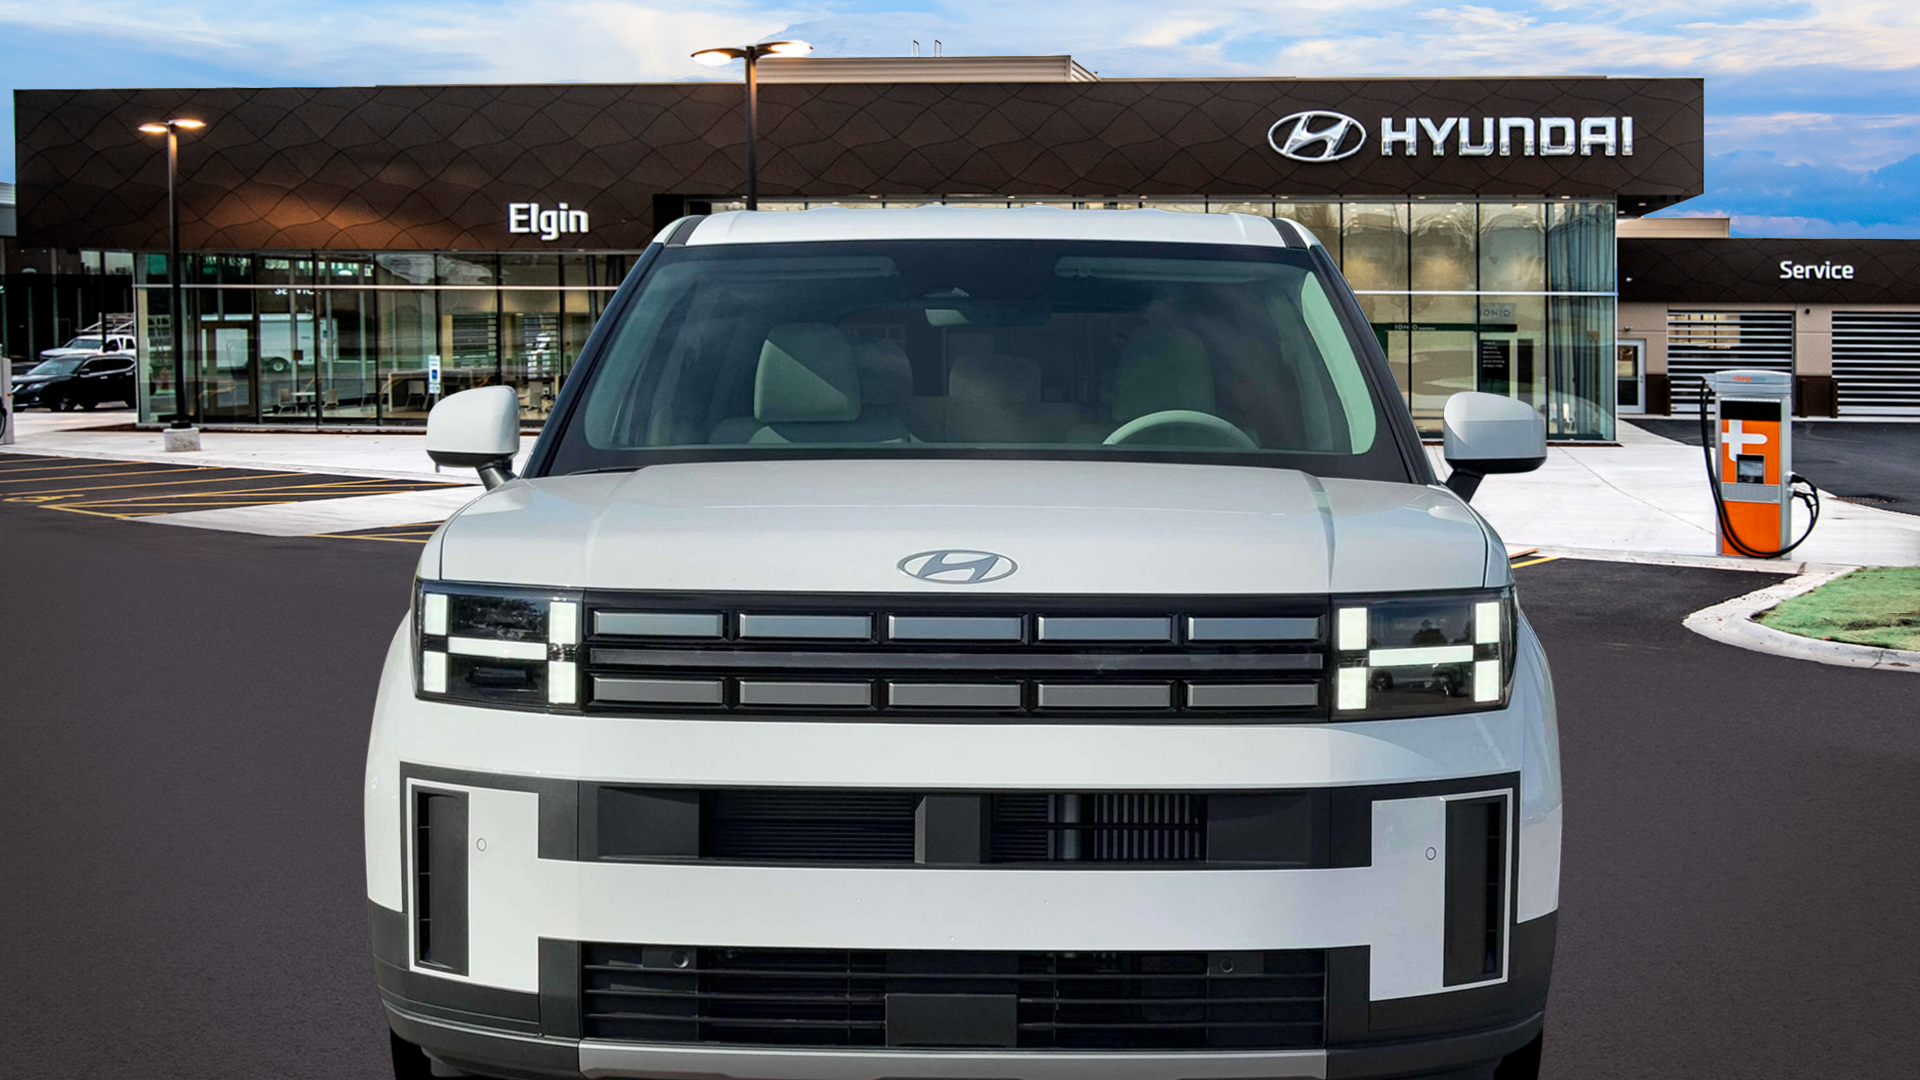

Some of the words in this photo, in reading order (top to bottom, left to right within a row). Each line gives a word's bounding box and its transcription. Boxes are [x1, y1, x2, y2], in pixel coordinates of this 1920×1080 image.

[1381, 117, 1633, 156] HYUNDAI
[508, 203, 590, 241] Elgin
[1780, 261, 1854, 279] Service
